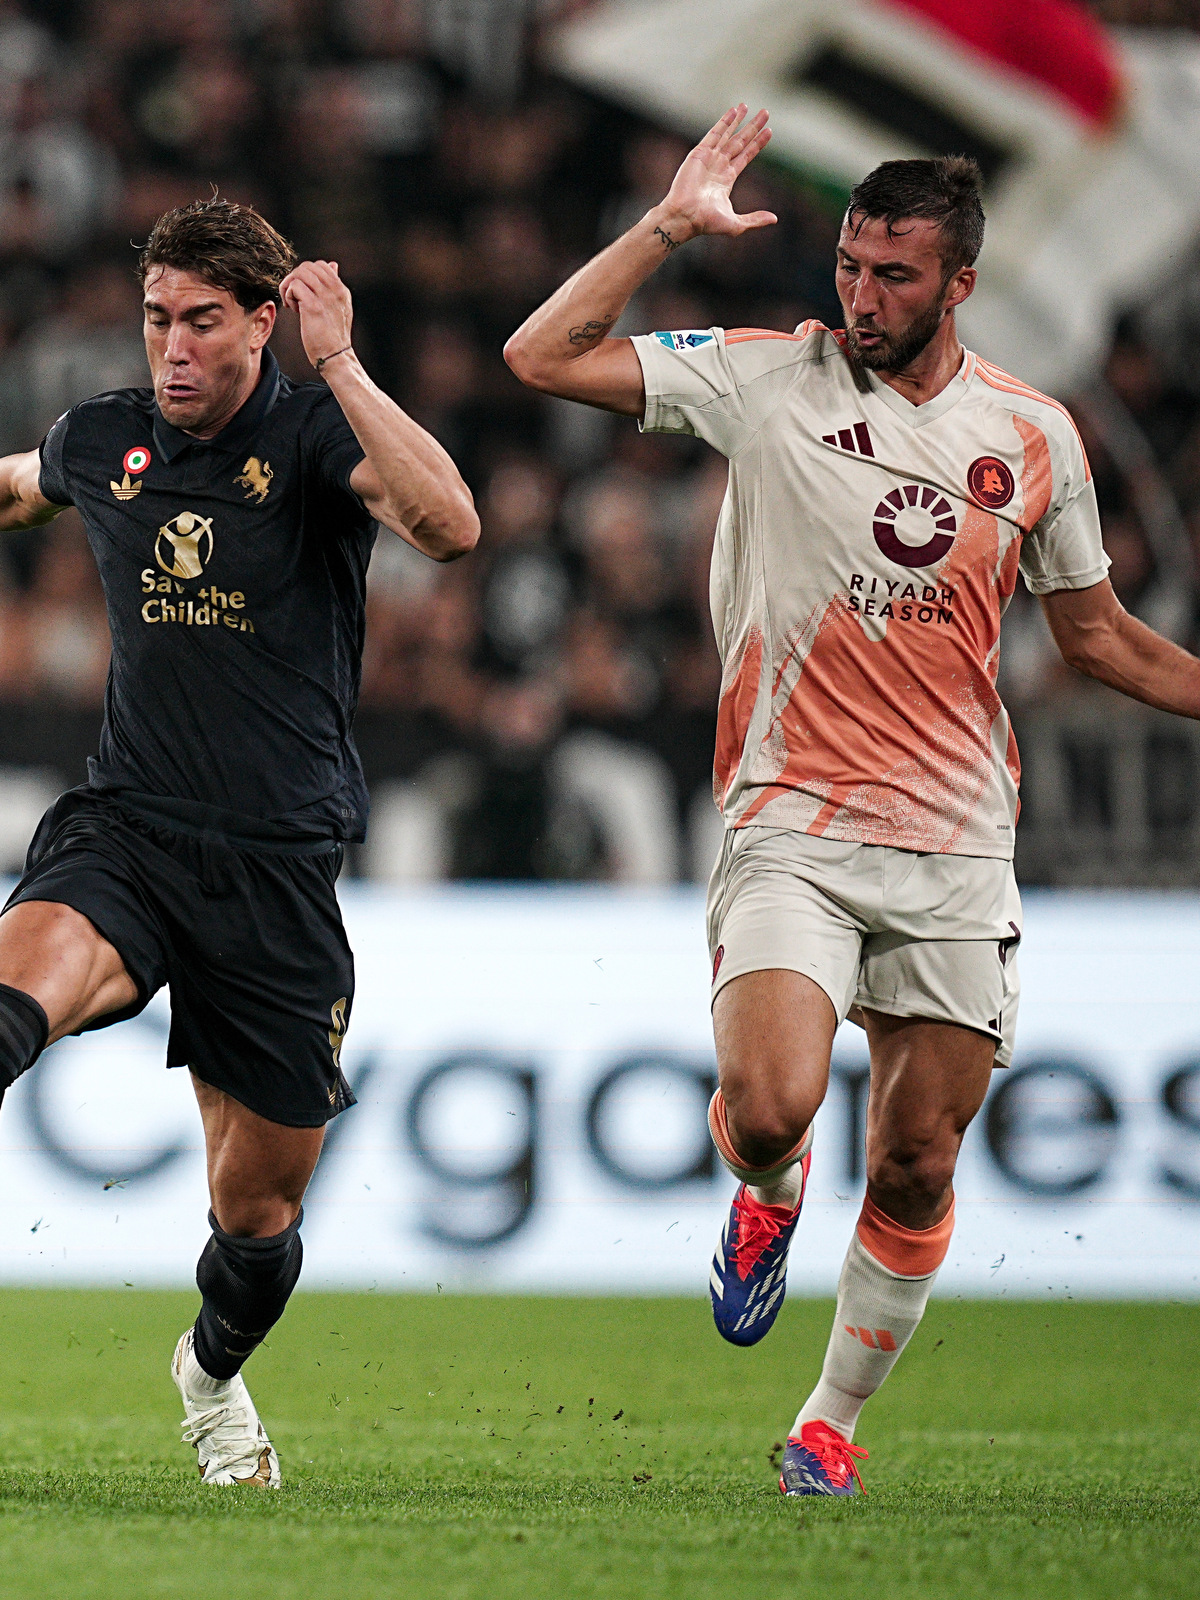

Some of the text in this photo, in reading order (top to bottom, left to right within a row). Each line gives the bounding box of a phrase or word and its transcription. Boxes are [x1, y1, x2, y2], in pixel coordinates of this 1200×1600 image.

[141, 568, 246, 609] Sav the
[849, 574, 955, 606] RIYADH
[141, 598, 256, 634] Children
[847, 595, 954, 625] SEASON
[328, 996, 347, 1068] 9
